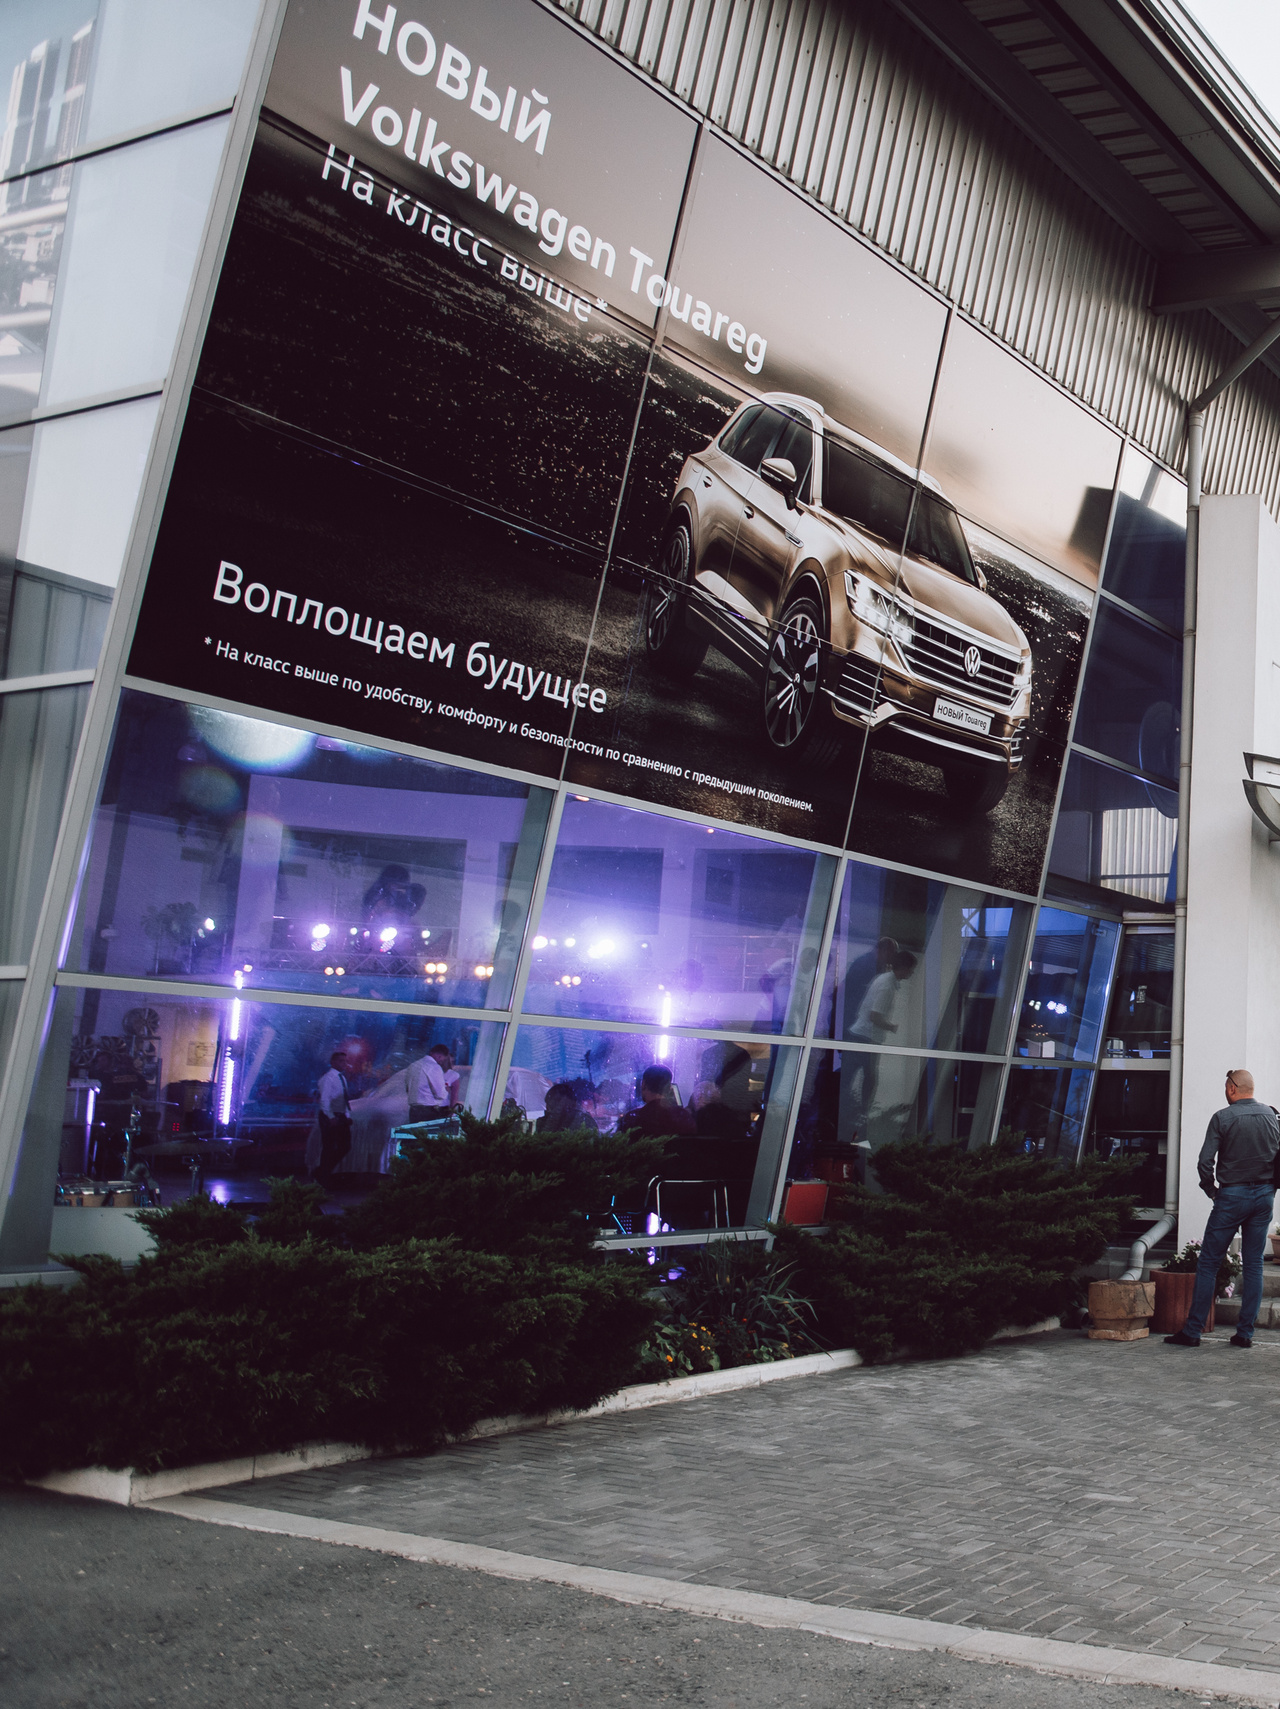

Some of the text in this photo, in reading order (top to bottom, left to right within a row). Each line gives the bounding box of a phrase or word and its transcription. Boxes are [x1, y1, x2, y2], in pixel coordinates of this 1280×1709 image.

[352, 0, 552, 156] НОВЫЙ
[321, 143, 376, 206] На
[385, 187, 493, 266] класс
[340, 66, 769, 375] Volkswagen Touareg
[212, 560, 608, 714] Воплощаем будущее
[215, 639, 814, 812] На класс выше по удобству, комфорту и безопасности по сравнению с предыдущим поколением.
[937, 704, 988, 731] НОВЫЙ Touareg
